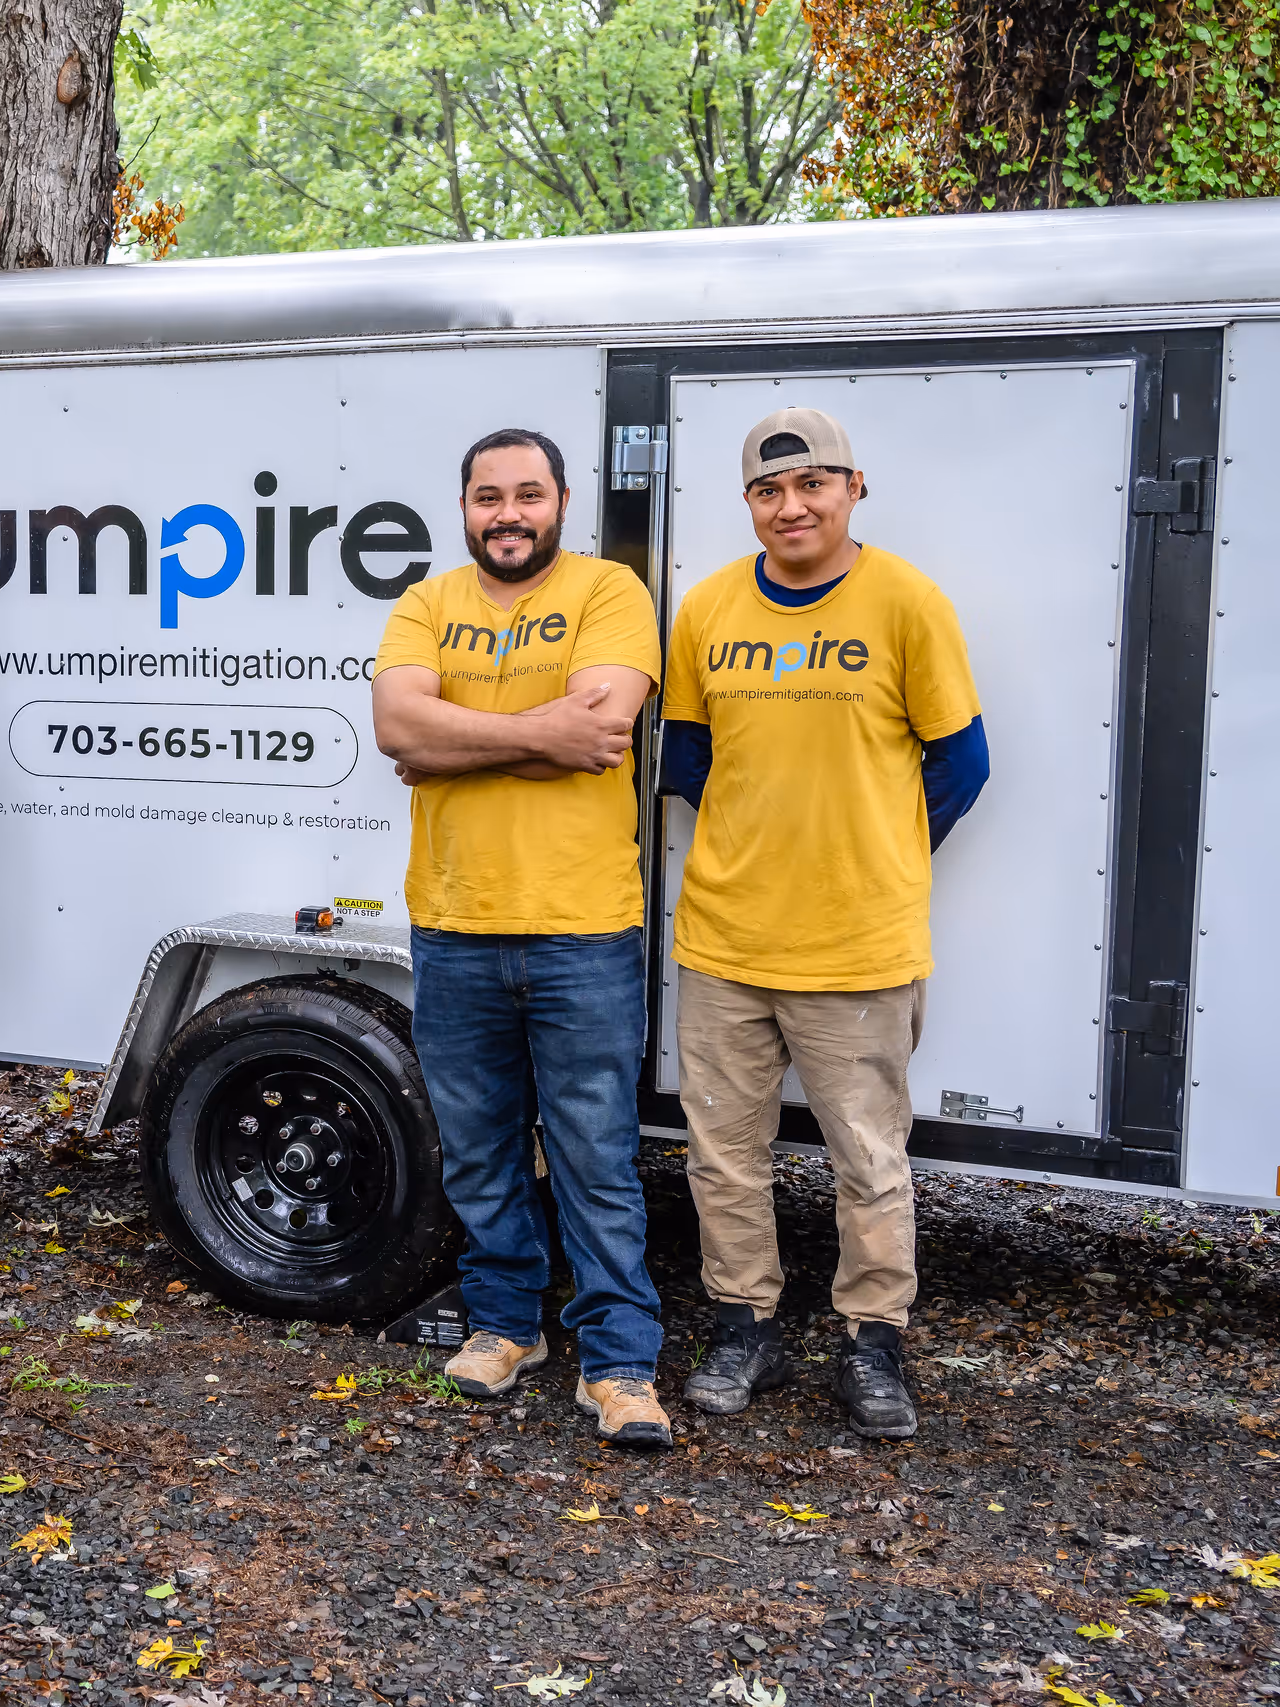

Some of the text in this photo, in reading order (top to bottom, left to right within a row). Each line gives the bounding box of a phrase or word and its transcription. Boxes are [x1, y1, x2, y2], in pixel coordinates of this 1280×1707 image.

[708, 630, 870, 682] umpire
[48, 724, 315, 762] 703-665-1129
[11, 801, 56, 817] water,
[60, 803, 90, 817] and
[95, 804, 135, 819] mold
[140, 805, 207, 825] damage
[211, 808, 278, 828] cleanup
[282, 812, 294, 826] &
[299, 813, 391, 831] restoration
[336, 907, 352, 915] NOT
[344, 899, 382, 909] CAUTION
